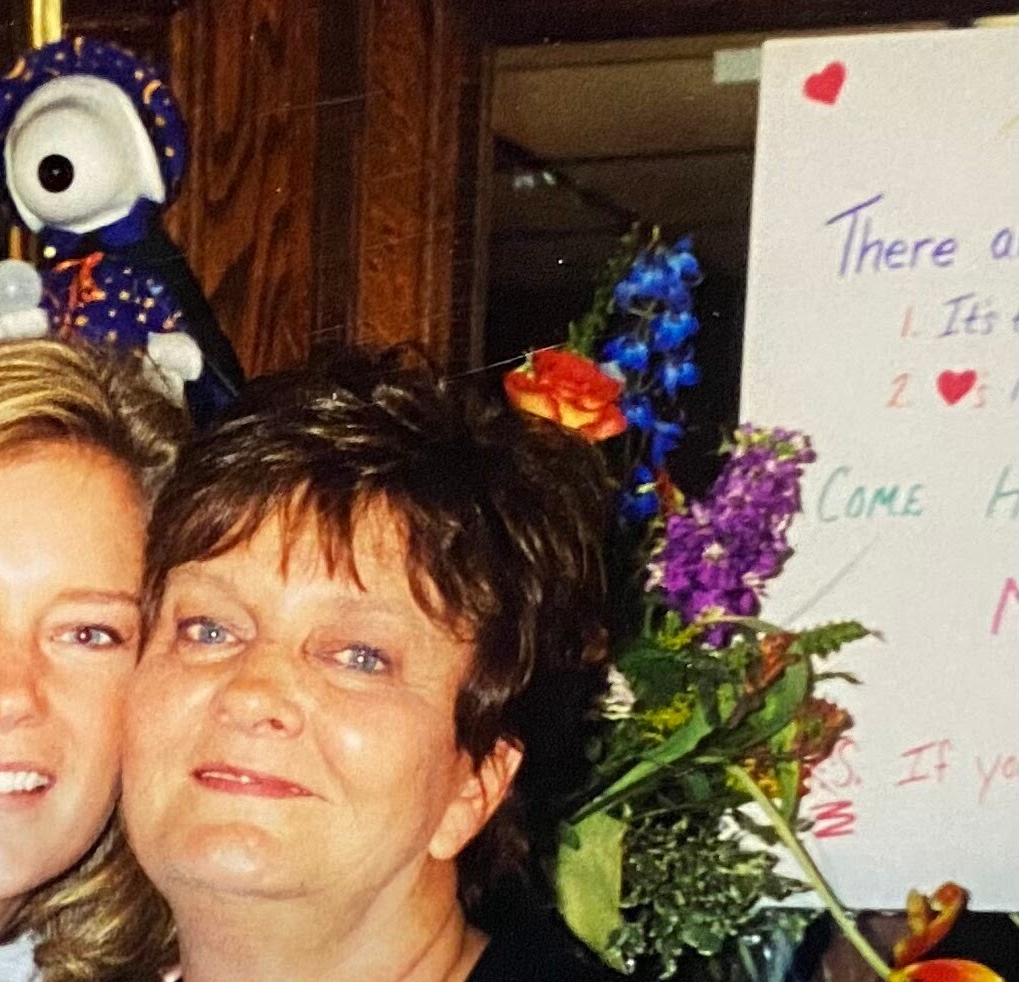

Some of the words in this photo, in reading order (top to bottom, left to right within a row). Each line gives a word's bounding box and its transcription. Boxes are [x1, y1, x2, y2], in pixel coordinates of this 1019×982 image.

[826, 193, 957, 279] There
[991, 227, 1019, 261] a
[895, 739, 952, 786] If
